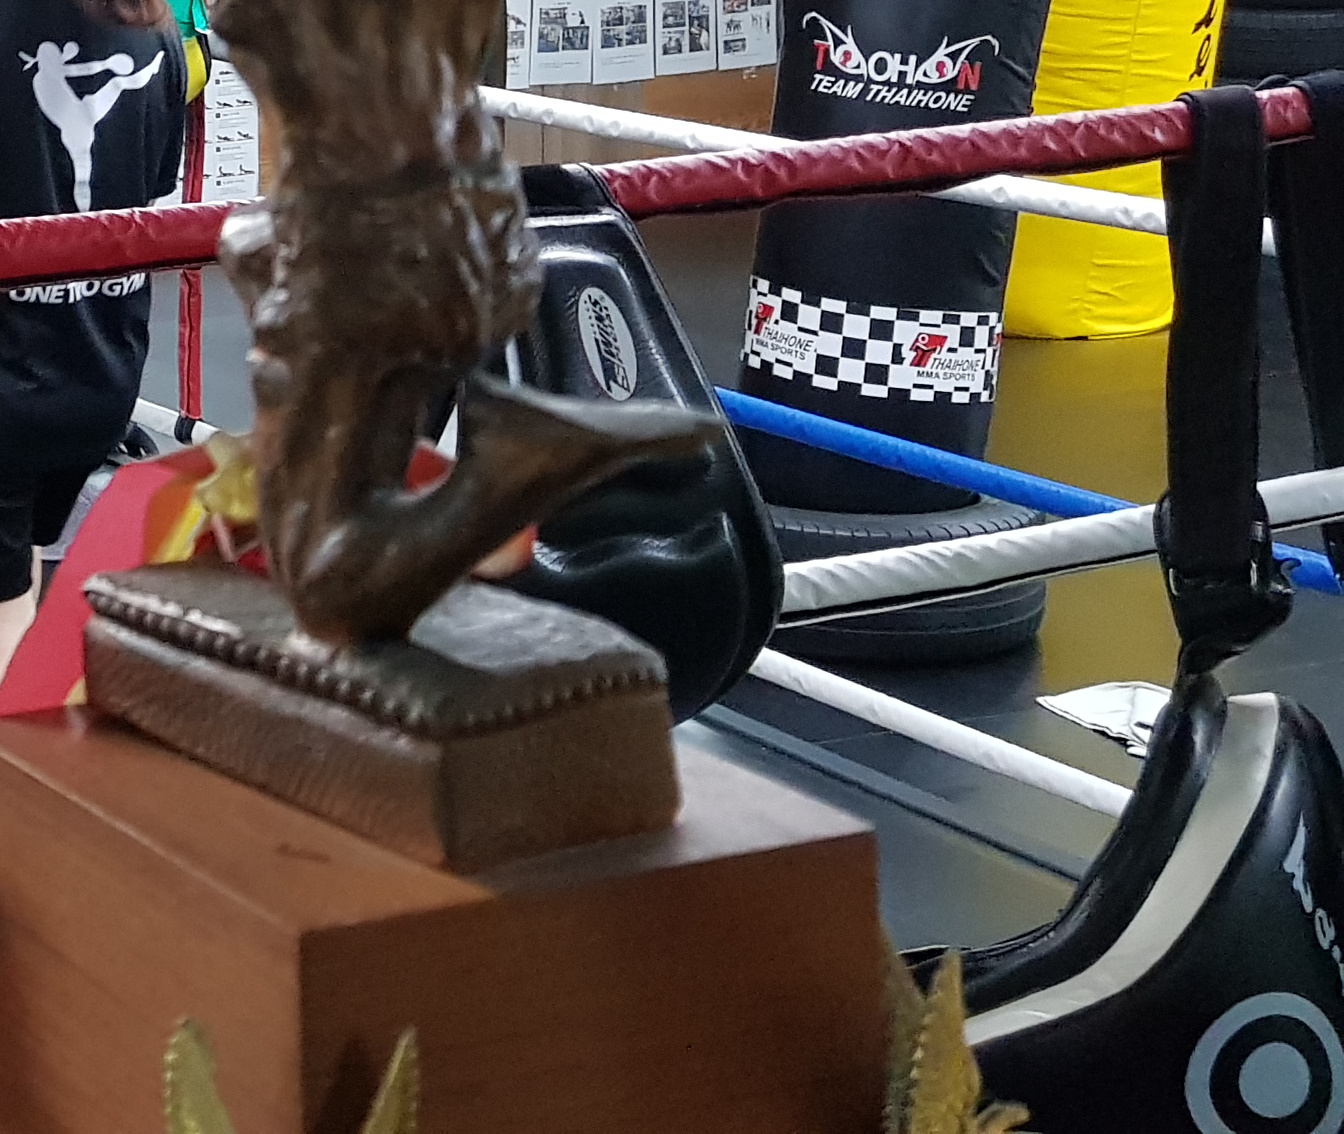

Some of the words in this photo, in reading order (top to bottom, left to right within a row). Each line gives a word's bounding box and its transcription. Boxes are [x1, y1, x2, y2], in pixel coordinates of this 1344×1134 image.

[810, 73, 864, 100] TEAM
[865, 84, 975, 112] THAIHONE
[9, 284, 66, 304] ONE
[763, 327, 814, 352] THAIHONE
[770, 343, 806, 361] SPORTS
[931, 357, 981, 372] THAIHONE
[917, 370, 940, 380] MMA
[942, 372, 975, 382] SPORTS
